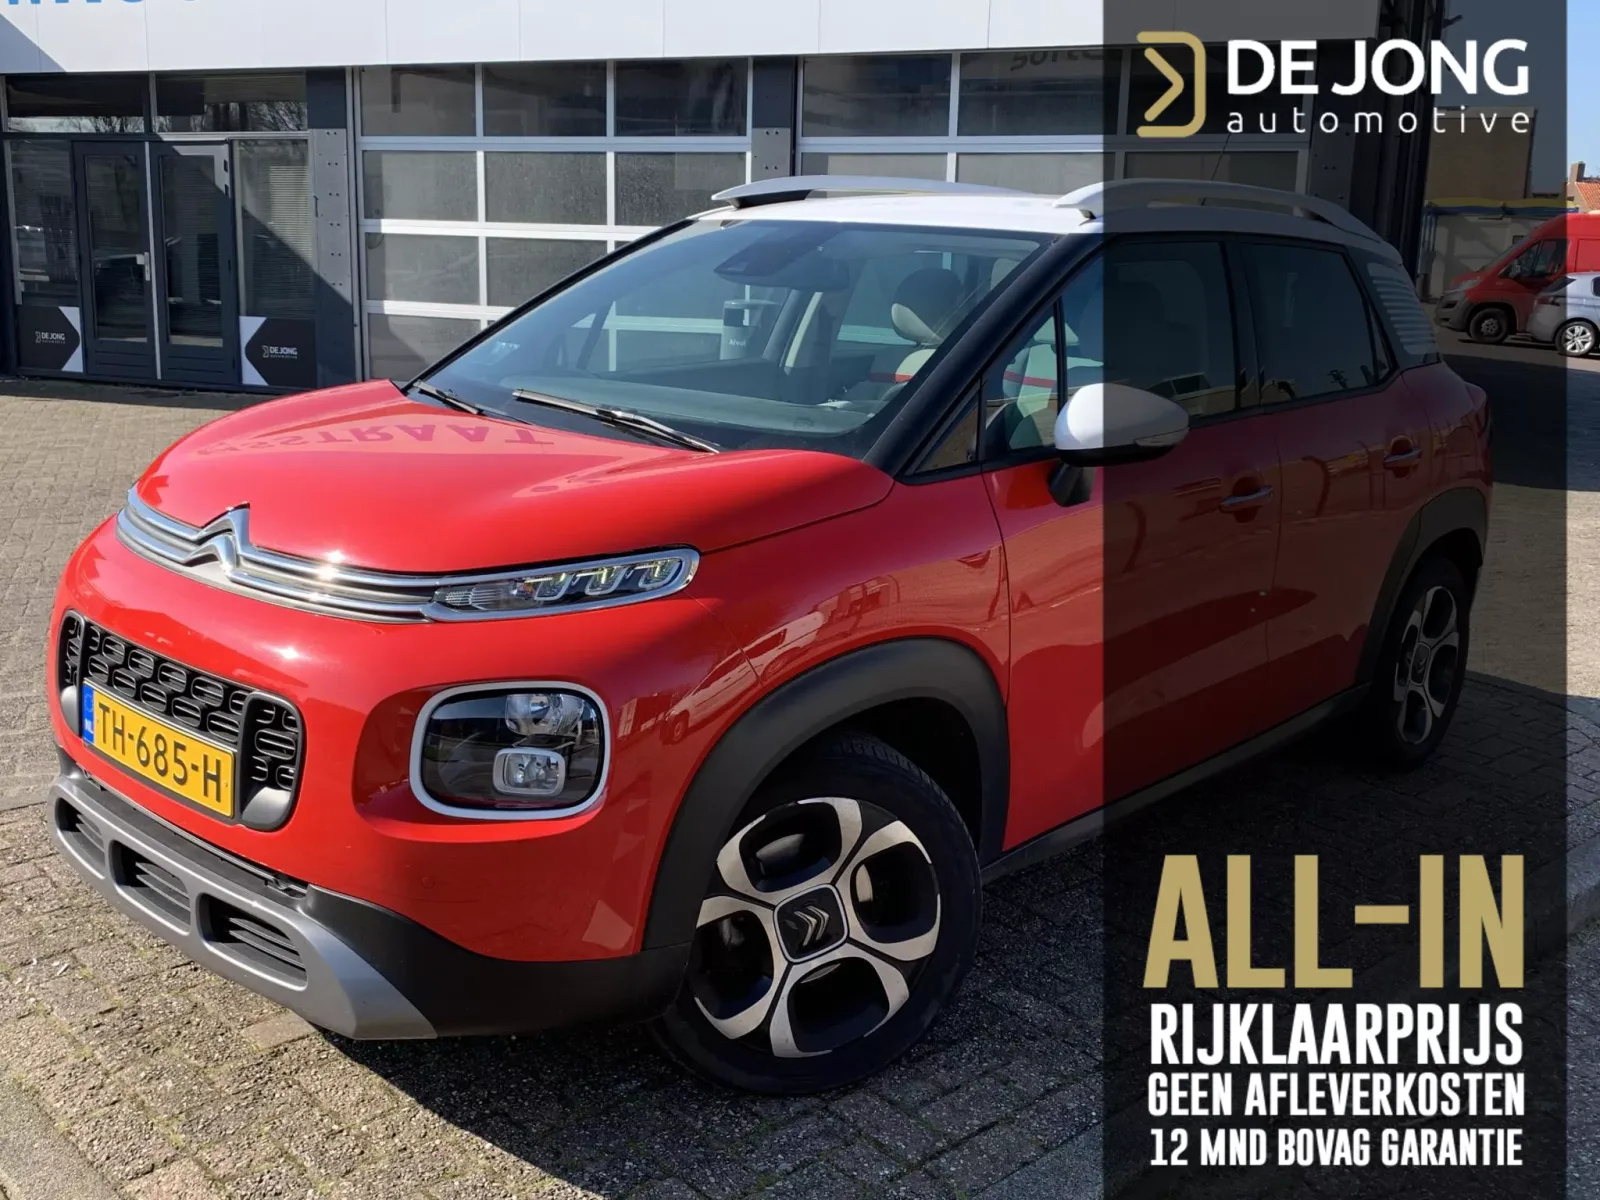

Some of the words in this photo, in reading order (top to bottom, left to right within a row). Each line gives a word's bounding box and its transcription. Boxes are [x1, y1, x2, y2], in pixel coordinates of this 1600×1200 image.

[41, 331, 49, 339] DE
[50, 332, 65, 341] JONG
[269, 346, 279, 354] DE
[280, 347, 298, 356] JONG
[98, 701, 222, 804] TH-685-H
